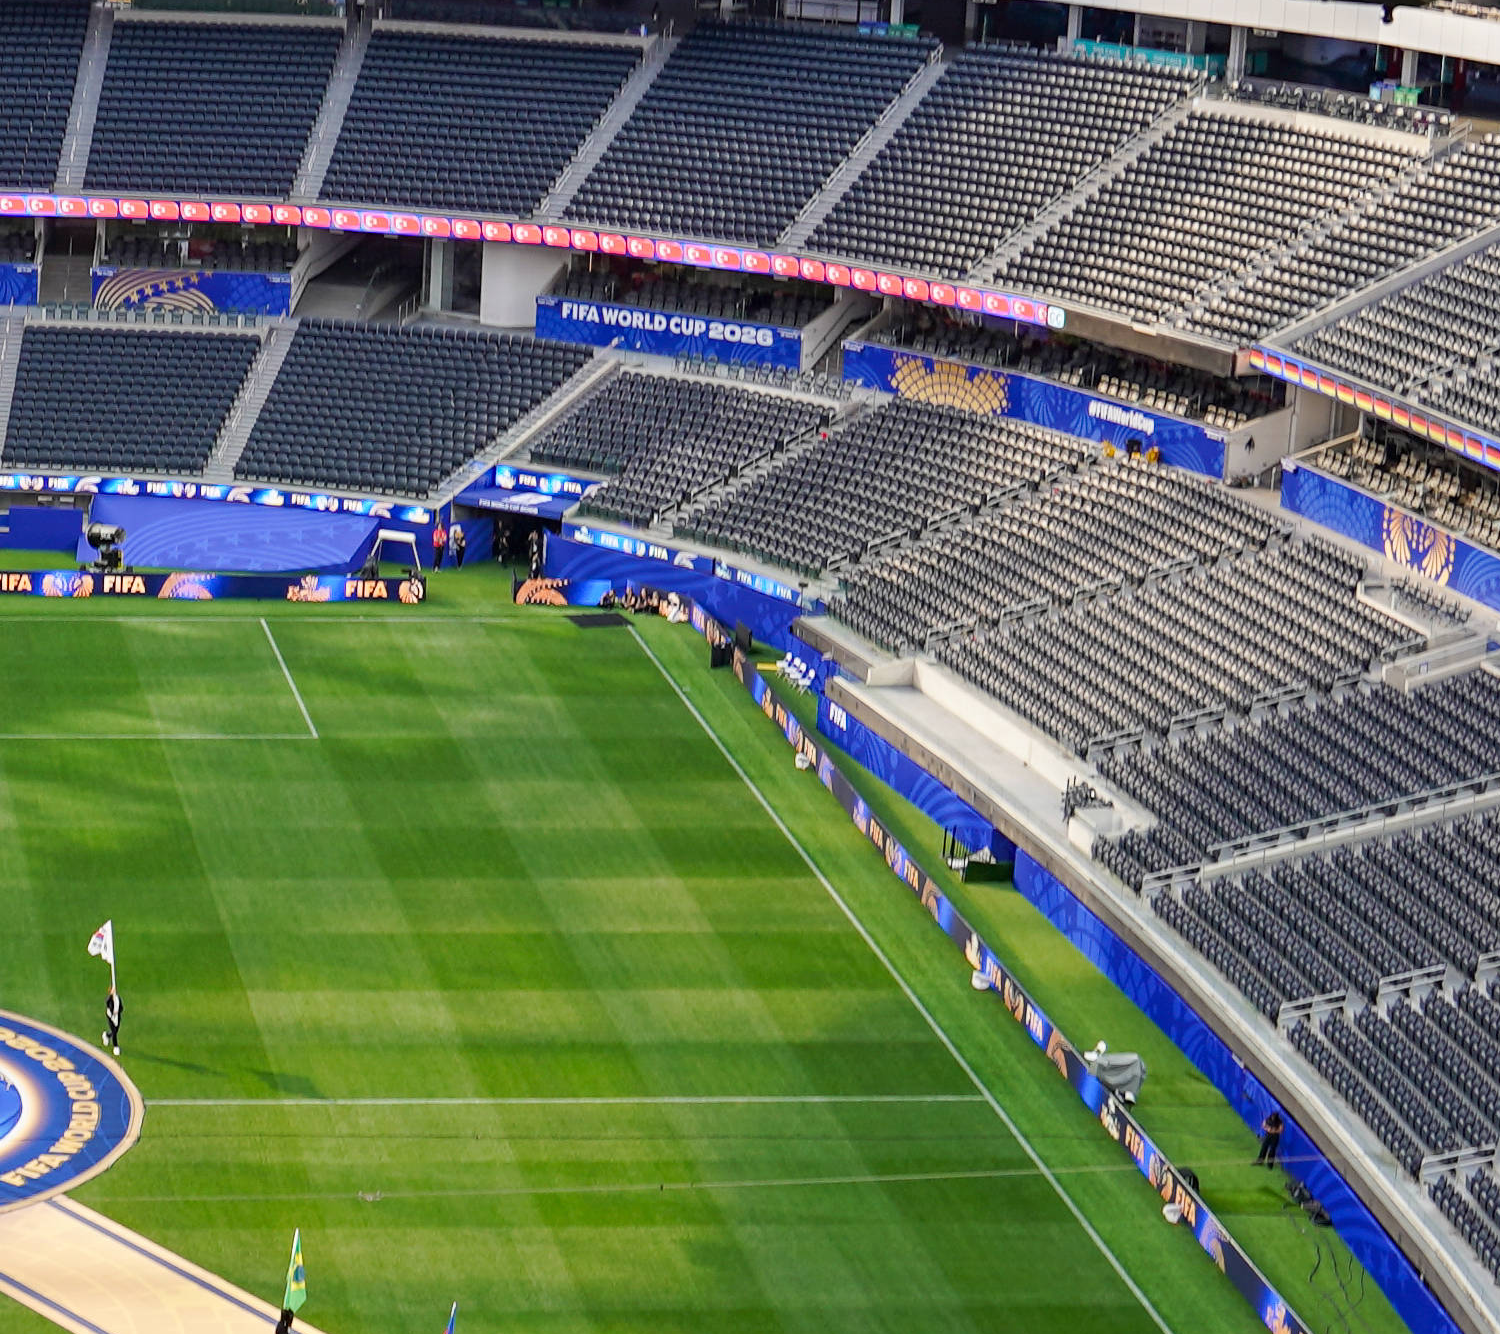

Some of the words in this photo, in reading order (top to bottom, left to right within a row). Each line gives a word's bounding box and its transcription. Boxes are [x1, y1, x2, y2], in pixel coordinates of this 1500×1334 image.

[562, 302, 599, 323] FIFA
[602, 307, 667, 331] WORLD
[670, 317, 706, 336] CUP
[709, 322, 773, 346] 2026
[1089, 400, 1154, 435] #FIFAWorldCup
[104, 576, 145, 593] FIFA
[346, 580, 387, 597] FIFA
[830, 702, 847, 731] FIFA
[870, 819, 882, 848] FIFA
[904, 860, 918, 890] FIFA
[985, 957, 1001, 990] FIFA
[1026, 1004, 1042, 1040] FIFA
[1125, 1126, 1144, 1162] FIFA
[1175, 1188, 1195, 1226] FIFA
